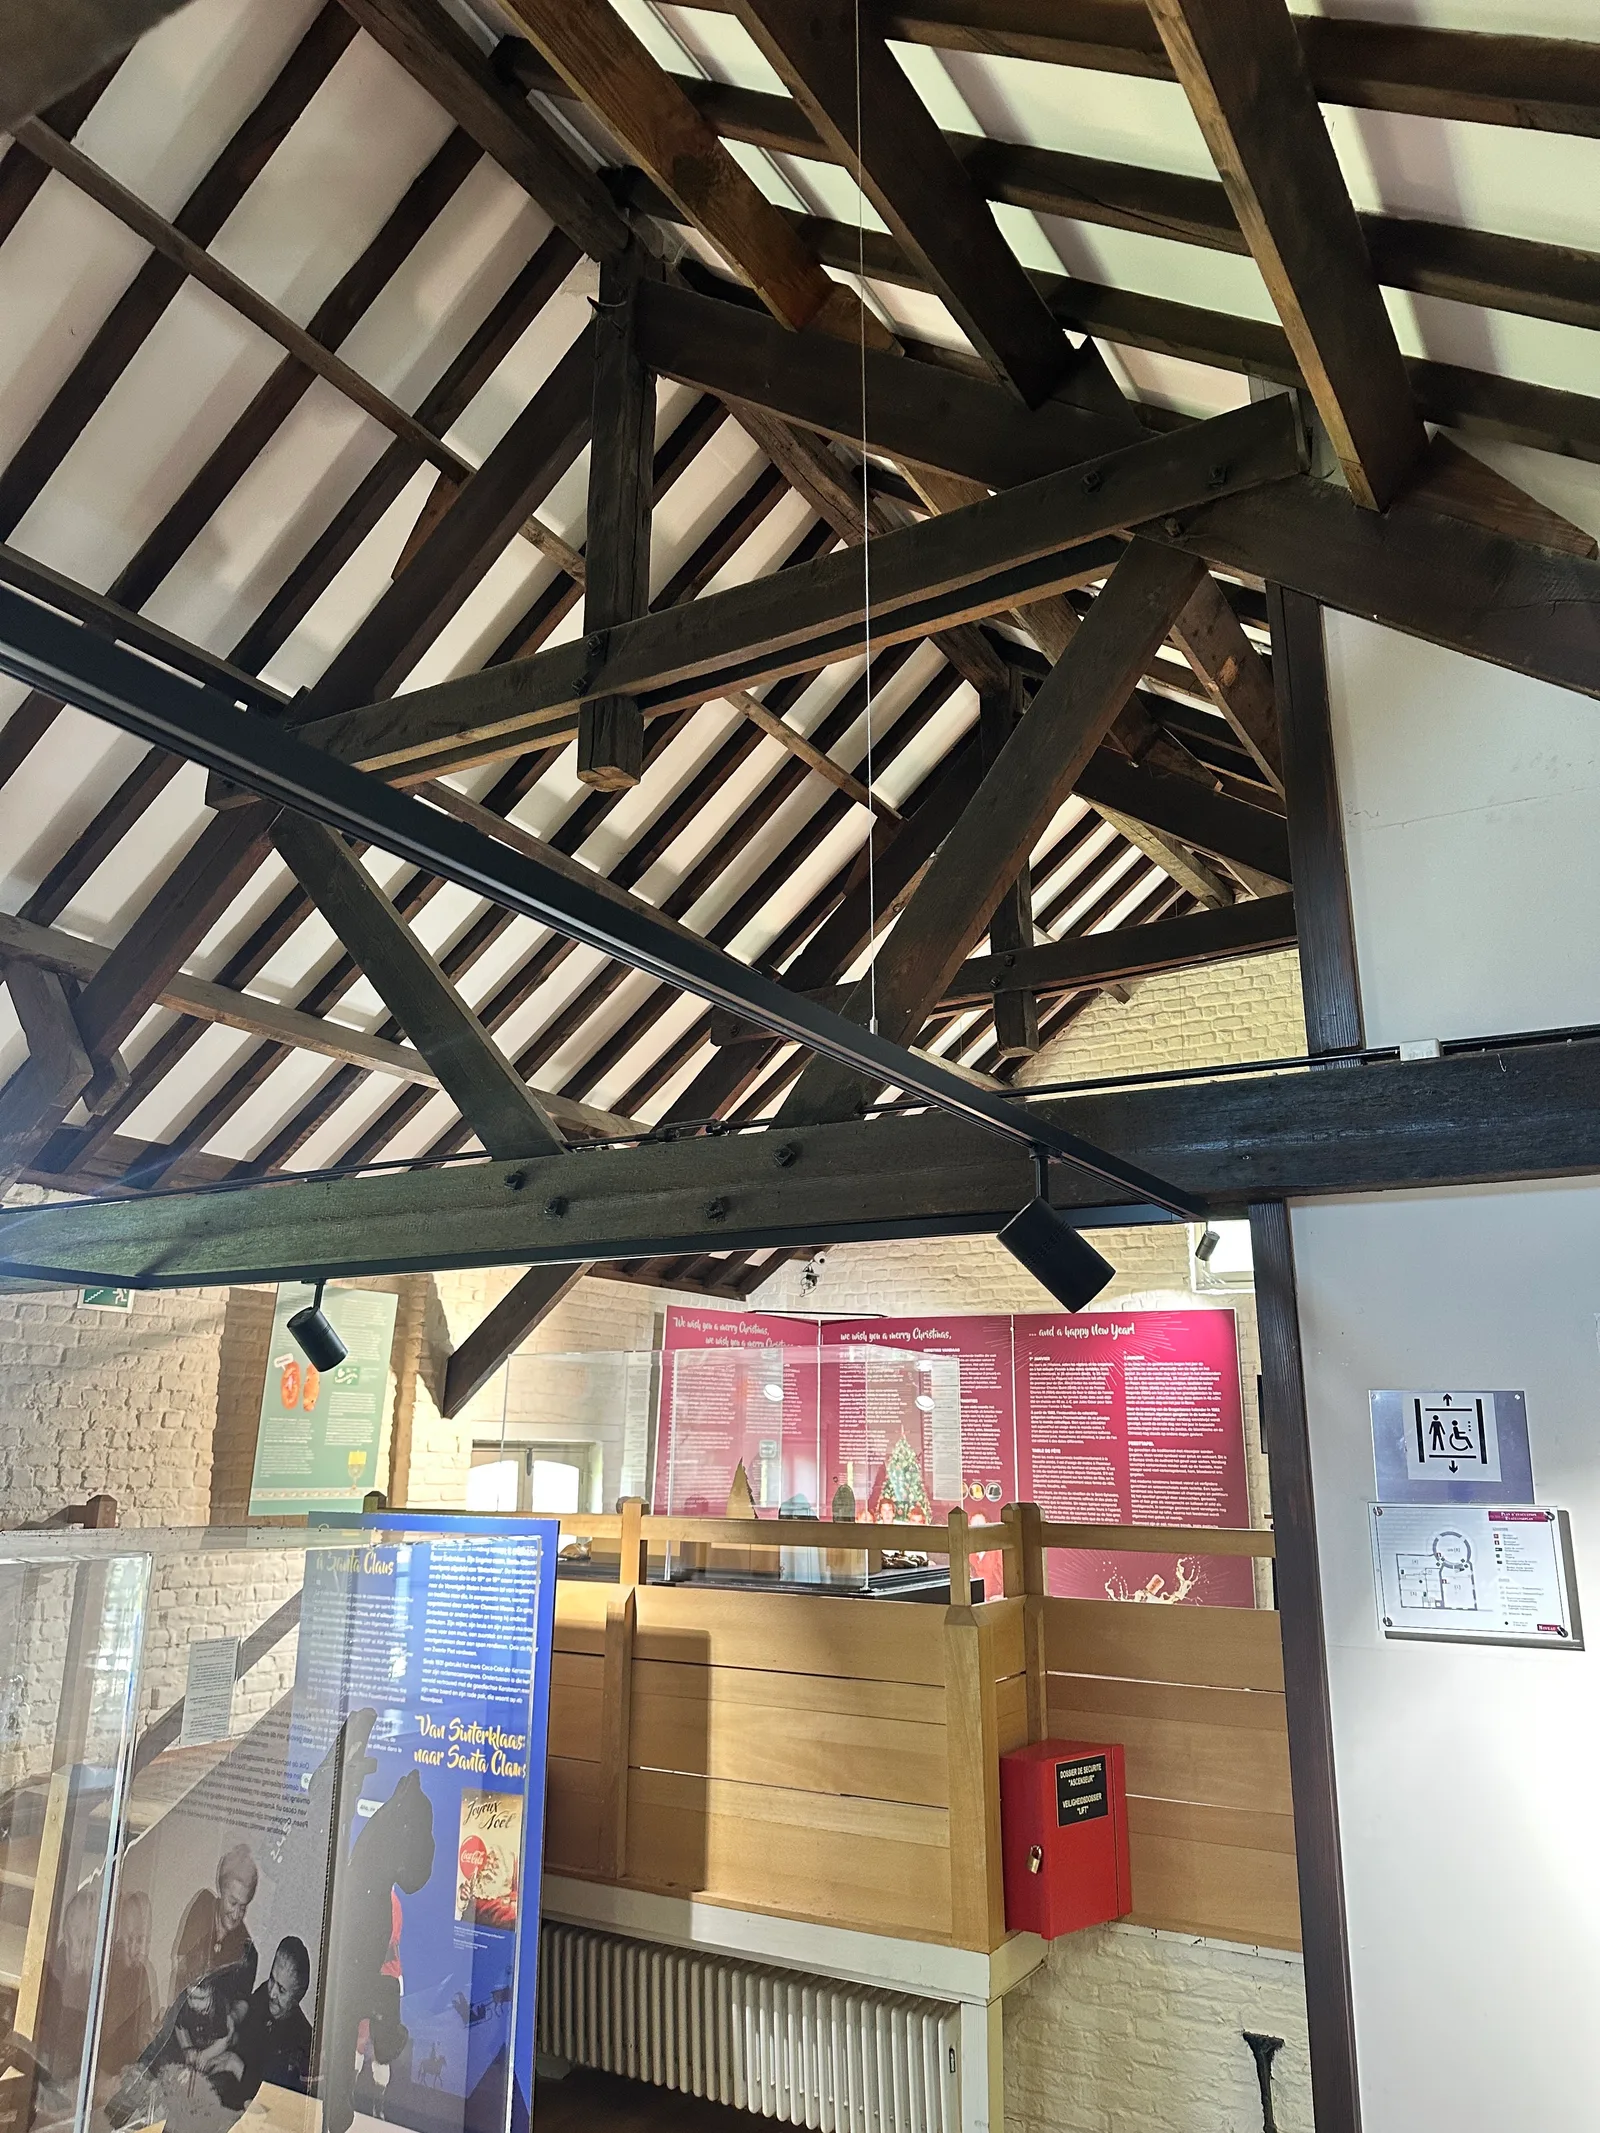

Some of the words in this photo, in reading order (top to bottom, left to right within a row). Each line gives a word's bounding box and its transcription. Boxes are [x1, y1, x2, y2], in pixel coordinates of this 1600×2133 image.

[673, 1316, 685, 1328] We
[687, 1320, 701, 1331] wish
[702, 1322, 712, 1332] you
[720, 1324, 738, 1334] merry
[852, 1331, 867, 1342] wish
[869, 1333, 880, 1342] you
[889, 1332, 911, 1342] merry
[912, 1327, 952, 1340] Christmas,
[1039, 1326, 1054, 1337] and
[1064, 1326, 1090, 1339] happy
[1091, 1323, 1109, 1335] New
[716, 1336, 729, 1347] wish
[364, 1551, 394, 1575] Claus
[415, 1714, 445, 1739] Van
[414, 1748, 444, 1766] naar
[447, 1744, 489, 1773] Santa
[1060, 1768, 1077, 1779] DOSSIER
[463, 1800, 502, 1825] Joyeux
[478, 1810, 517, 1830] Noël
